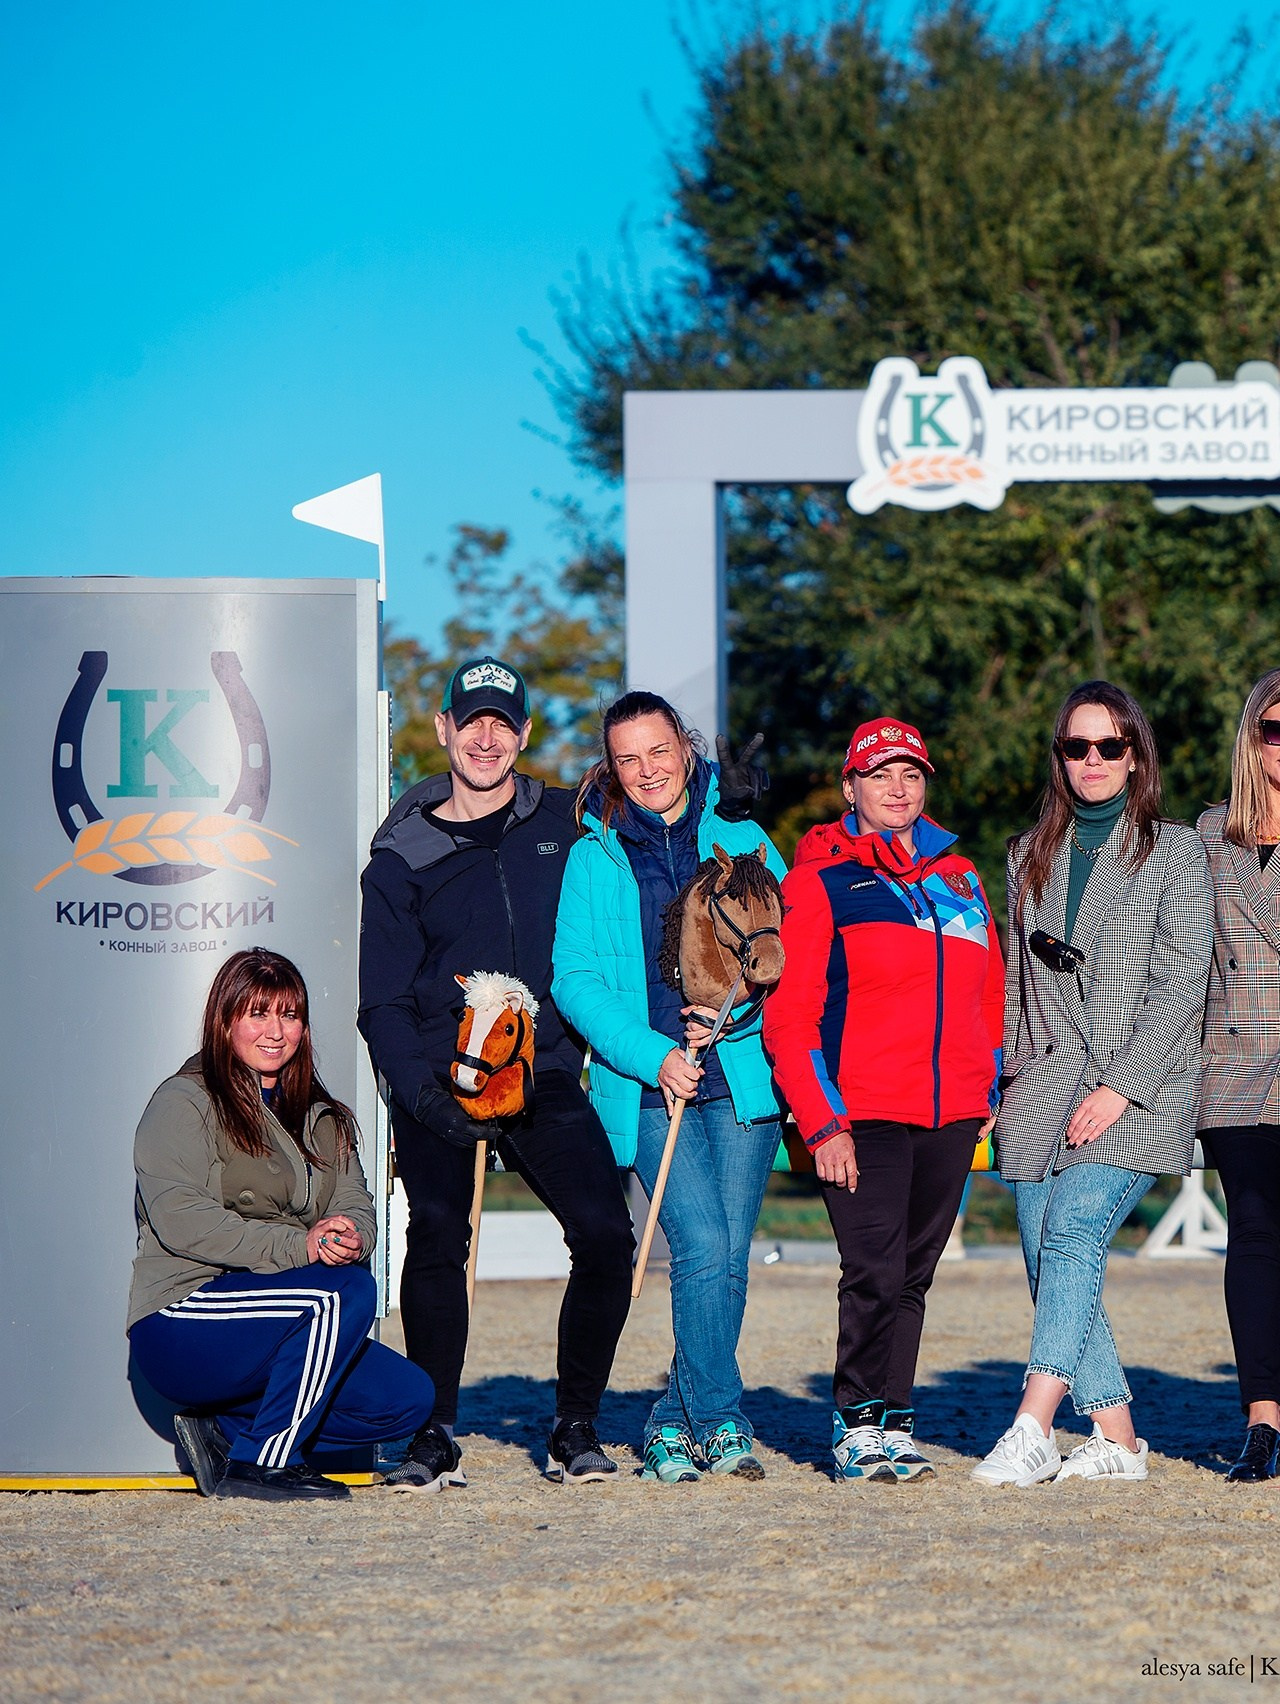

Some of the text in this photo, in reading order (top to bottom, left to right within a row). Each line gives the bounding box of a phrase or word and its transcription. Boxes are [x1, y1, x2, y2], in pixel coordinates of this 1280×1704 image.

[905, 393, 959, 447] К
[1007, 397, 1268, 432] КИРОВСКИЙ
[1007, 439, 1271, 465] КОННЫЙ ЗАВОД
[468, 664, 512, 680] STARS
[106, 688, 220, 799] К
[856, 733, 878, 753] RUS
[56, 896, 275, 932] КИРОВСКИЙ
[108, 939, 217, 954] КОННЫЙ ЗАВОД
